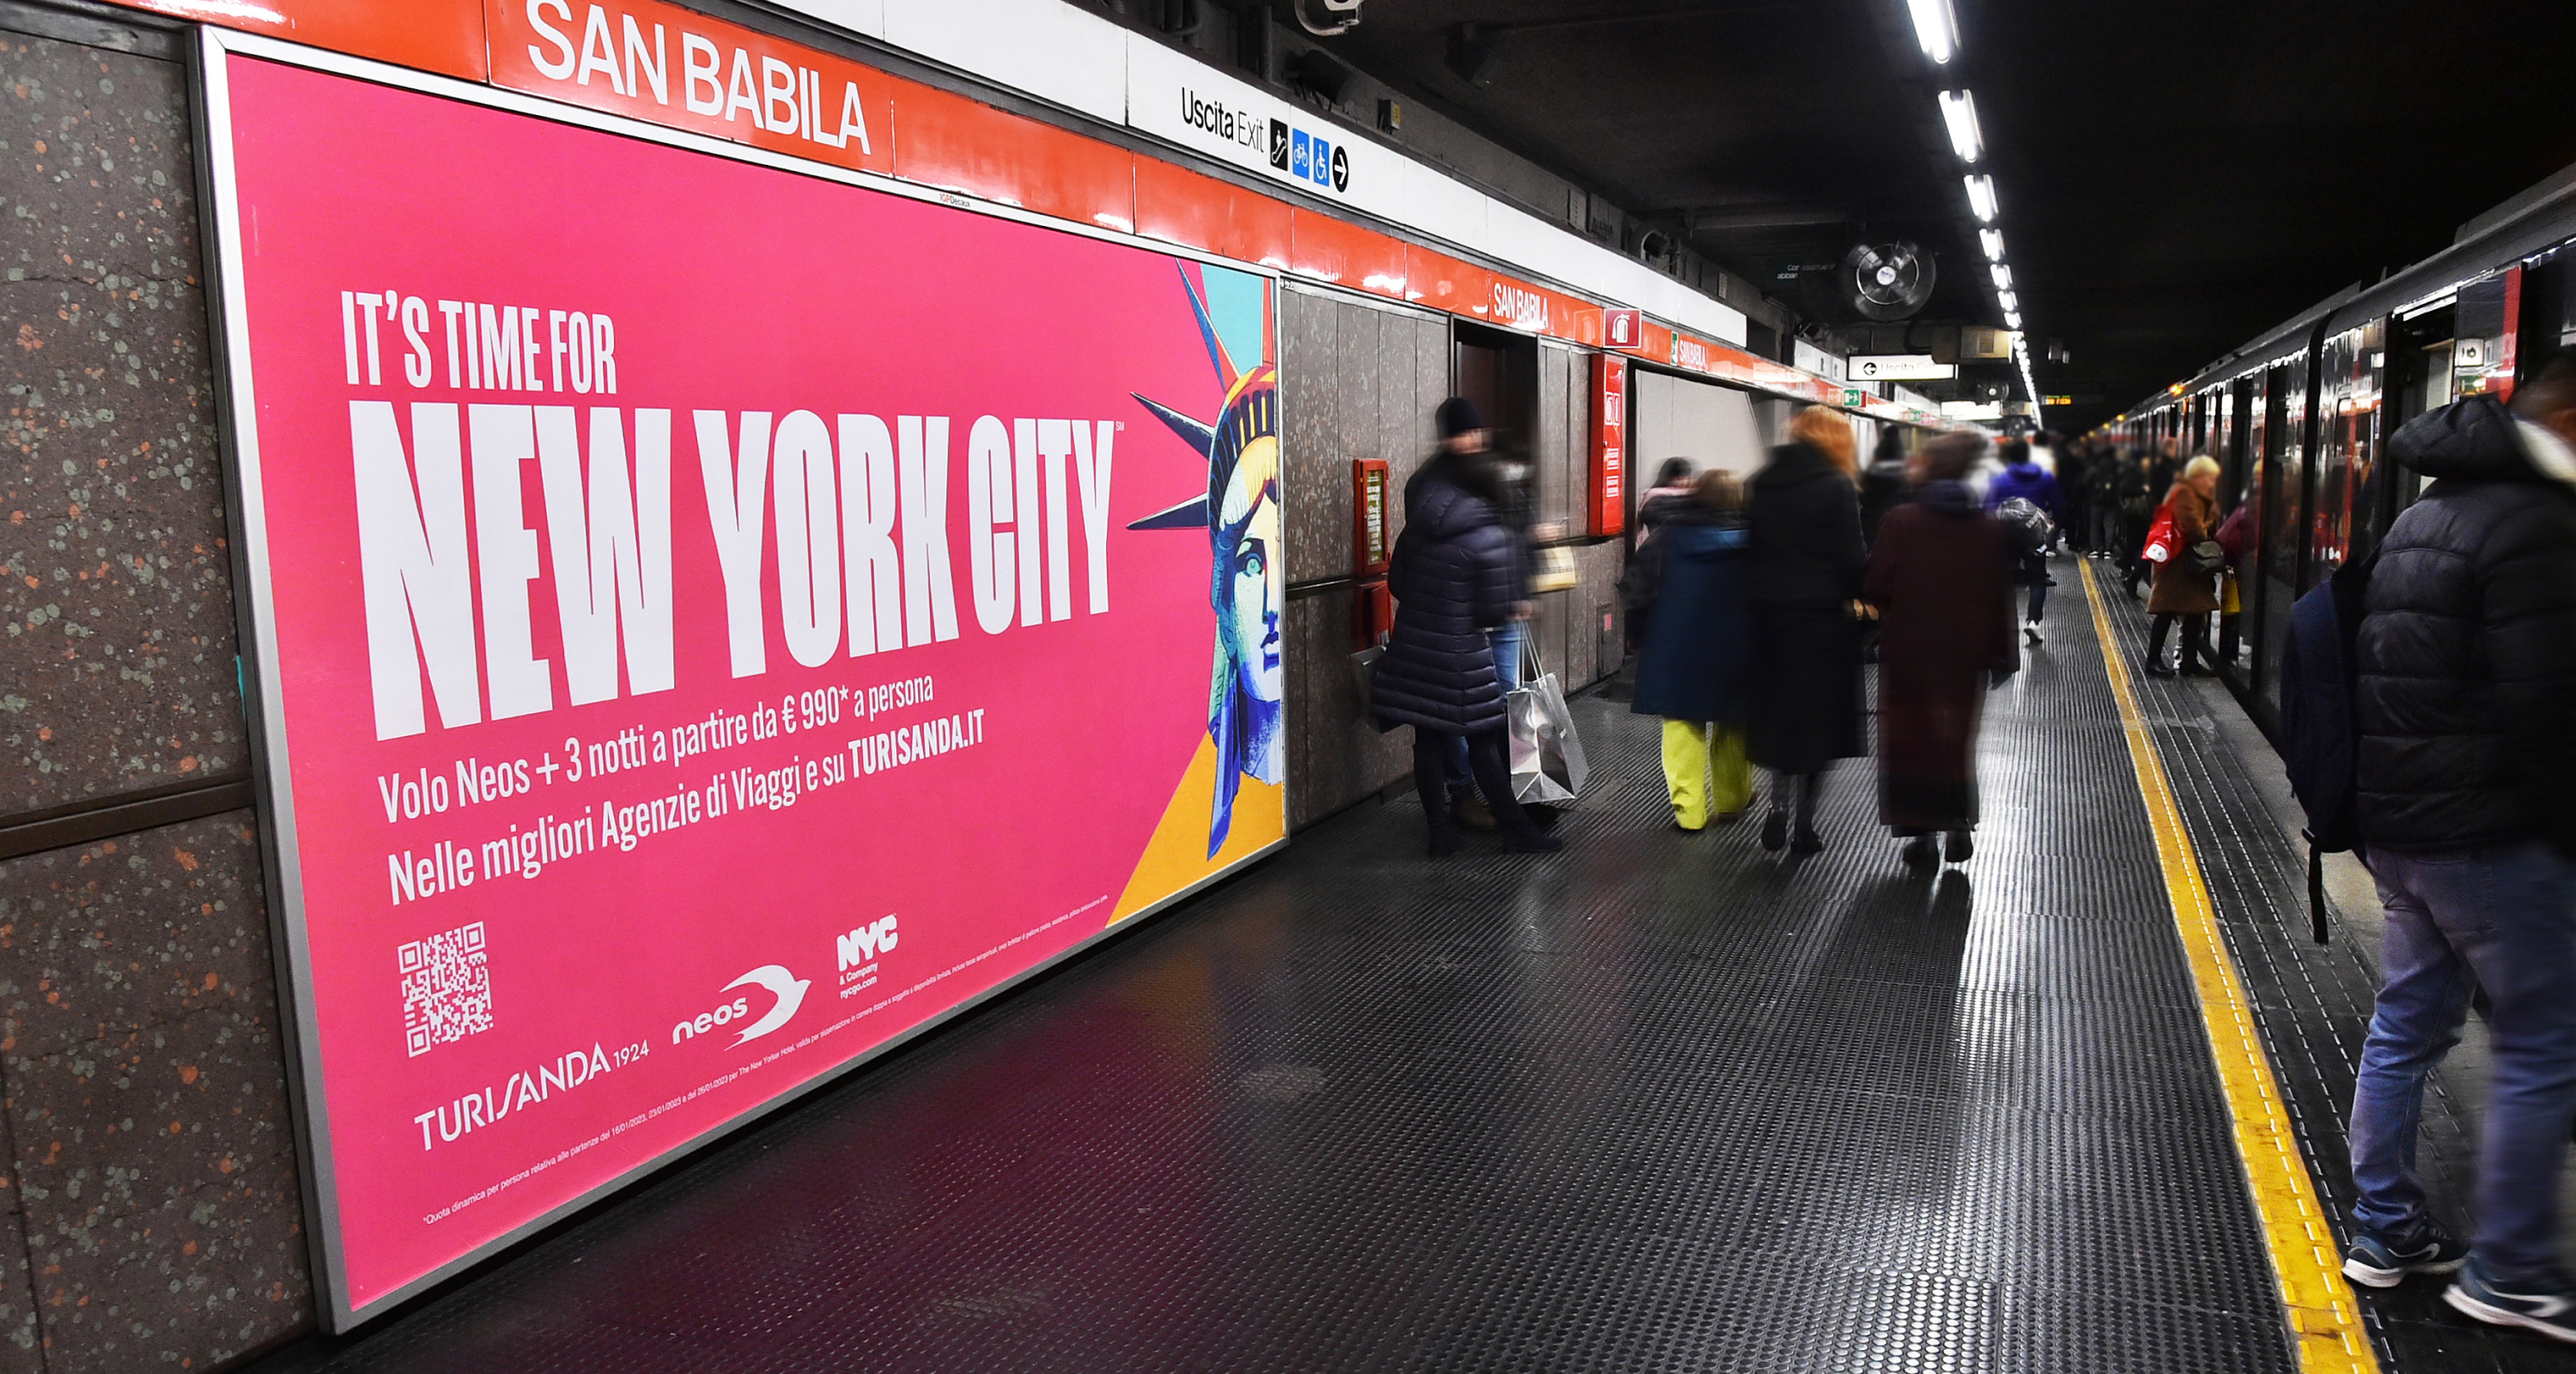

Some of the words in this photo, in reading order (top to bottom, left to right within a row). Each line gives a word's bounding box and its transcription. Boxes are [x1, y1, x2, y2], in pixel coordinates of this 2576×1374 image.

[526, 0, 668, 106] SAN
[683, 32, 872, 155] BABILA
[1182, 87, 1234, 141] Uscita
[1238, 111, 1264, 153] Exit
[439, 300, 544, 392] TIME
[550, 309, 617, 395] FOR
[1494, 283, 1516, 320] SAN
[1516, 289, 1549, 328] BABILA
[349, 400, 676, 741] NEW
[692, 409, 961, 679] YORK
[968, 415, 1115, 635] CITY
[378, 768, 449, 824] Volo
[455, 757, 532, 808] Neos
[535, 752, 560, 785] +
[565, 737, 583, 782] 3
[588, 724, 647, 778] notti
[652, 730, 667, 763] a
[672, 708, 748, 767] partire
[752, 701, 778, 741] da
[781, 695, 797, 733] €
[854, 690, 865, 718] a
[869, 675, 934, 721] persona
[388, 840, 475, 906] Nelle
[482, 806, 595, 879] migliori
[601, 783, 701, 852] Agenzie
[706, 773, 728, 818] di
[731, 755, 802, 811] Viaggi
[805, 759, 818, 792] e
[822, 753, 846, 787] su
[848, 708, 985, 778] TURISANDA.IT
[837, 915, 898, 972] NYC
[840, 976, 846, 986] &
[847, 962, 878, 982] Company
[841, 976, 878, 999] nycgo.com
[672, 996, 749, 1046] neos
[414, 1041, 611, 1151] TURISANDA
[613, 1039, 650, 1068] 1924
[452, 1191, 486, 1213] dinamica
[487, 1184, 500, 1198] per
[501, 1169, 530, 1191] persona
[531, 1156, 556, 1175] relativa
[557, 1151, 569, 1162] alle
[570, 1137, 599, 1158] partenze
[600, 1130, 611, 1141] del
[648, 1097, 682, 1119] 23/01/2023
[687, 1089, 696, 1101] del
[728, 1072, 738, 1083] per
[738, 1066, 750, 1076] The
[750, 1060, 762, 1072] New
